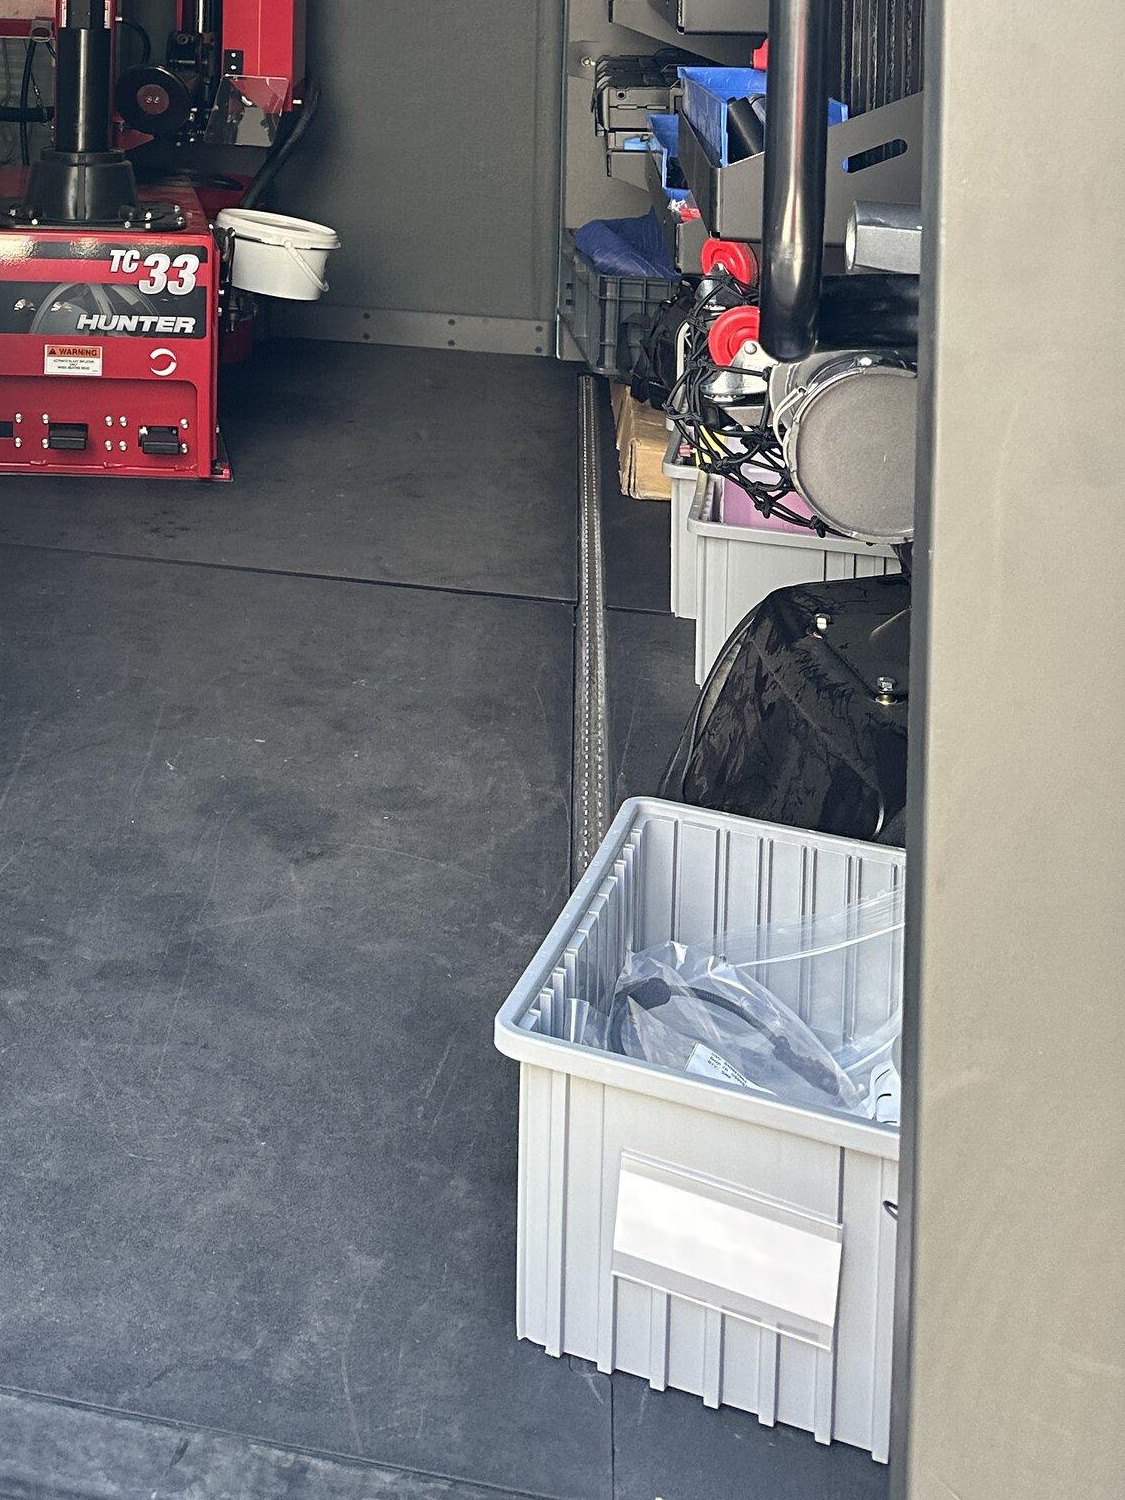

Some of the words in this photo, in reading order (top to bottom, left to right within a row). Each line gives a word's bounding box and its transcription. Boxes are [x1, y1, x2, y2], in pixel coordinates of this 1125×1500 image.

[109, 249, 141, 273] TC
[138, 253, 200, 296] 33
[76, 314, 196, 334] HUNTER
[59, 348, 97, 357] WARNING
